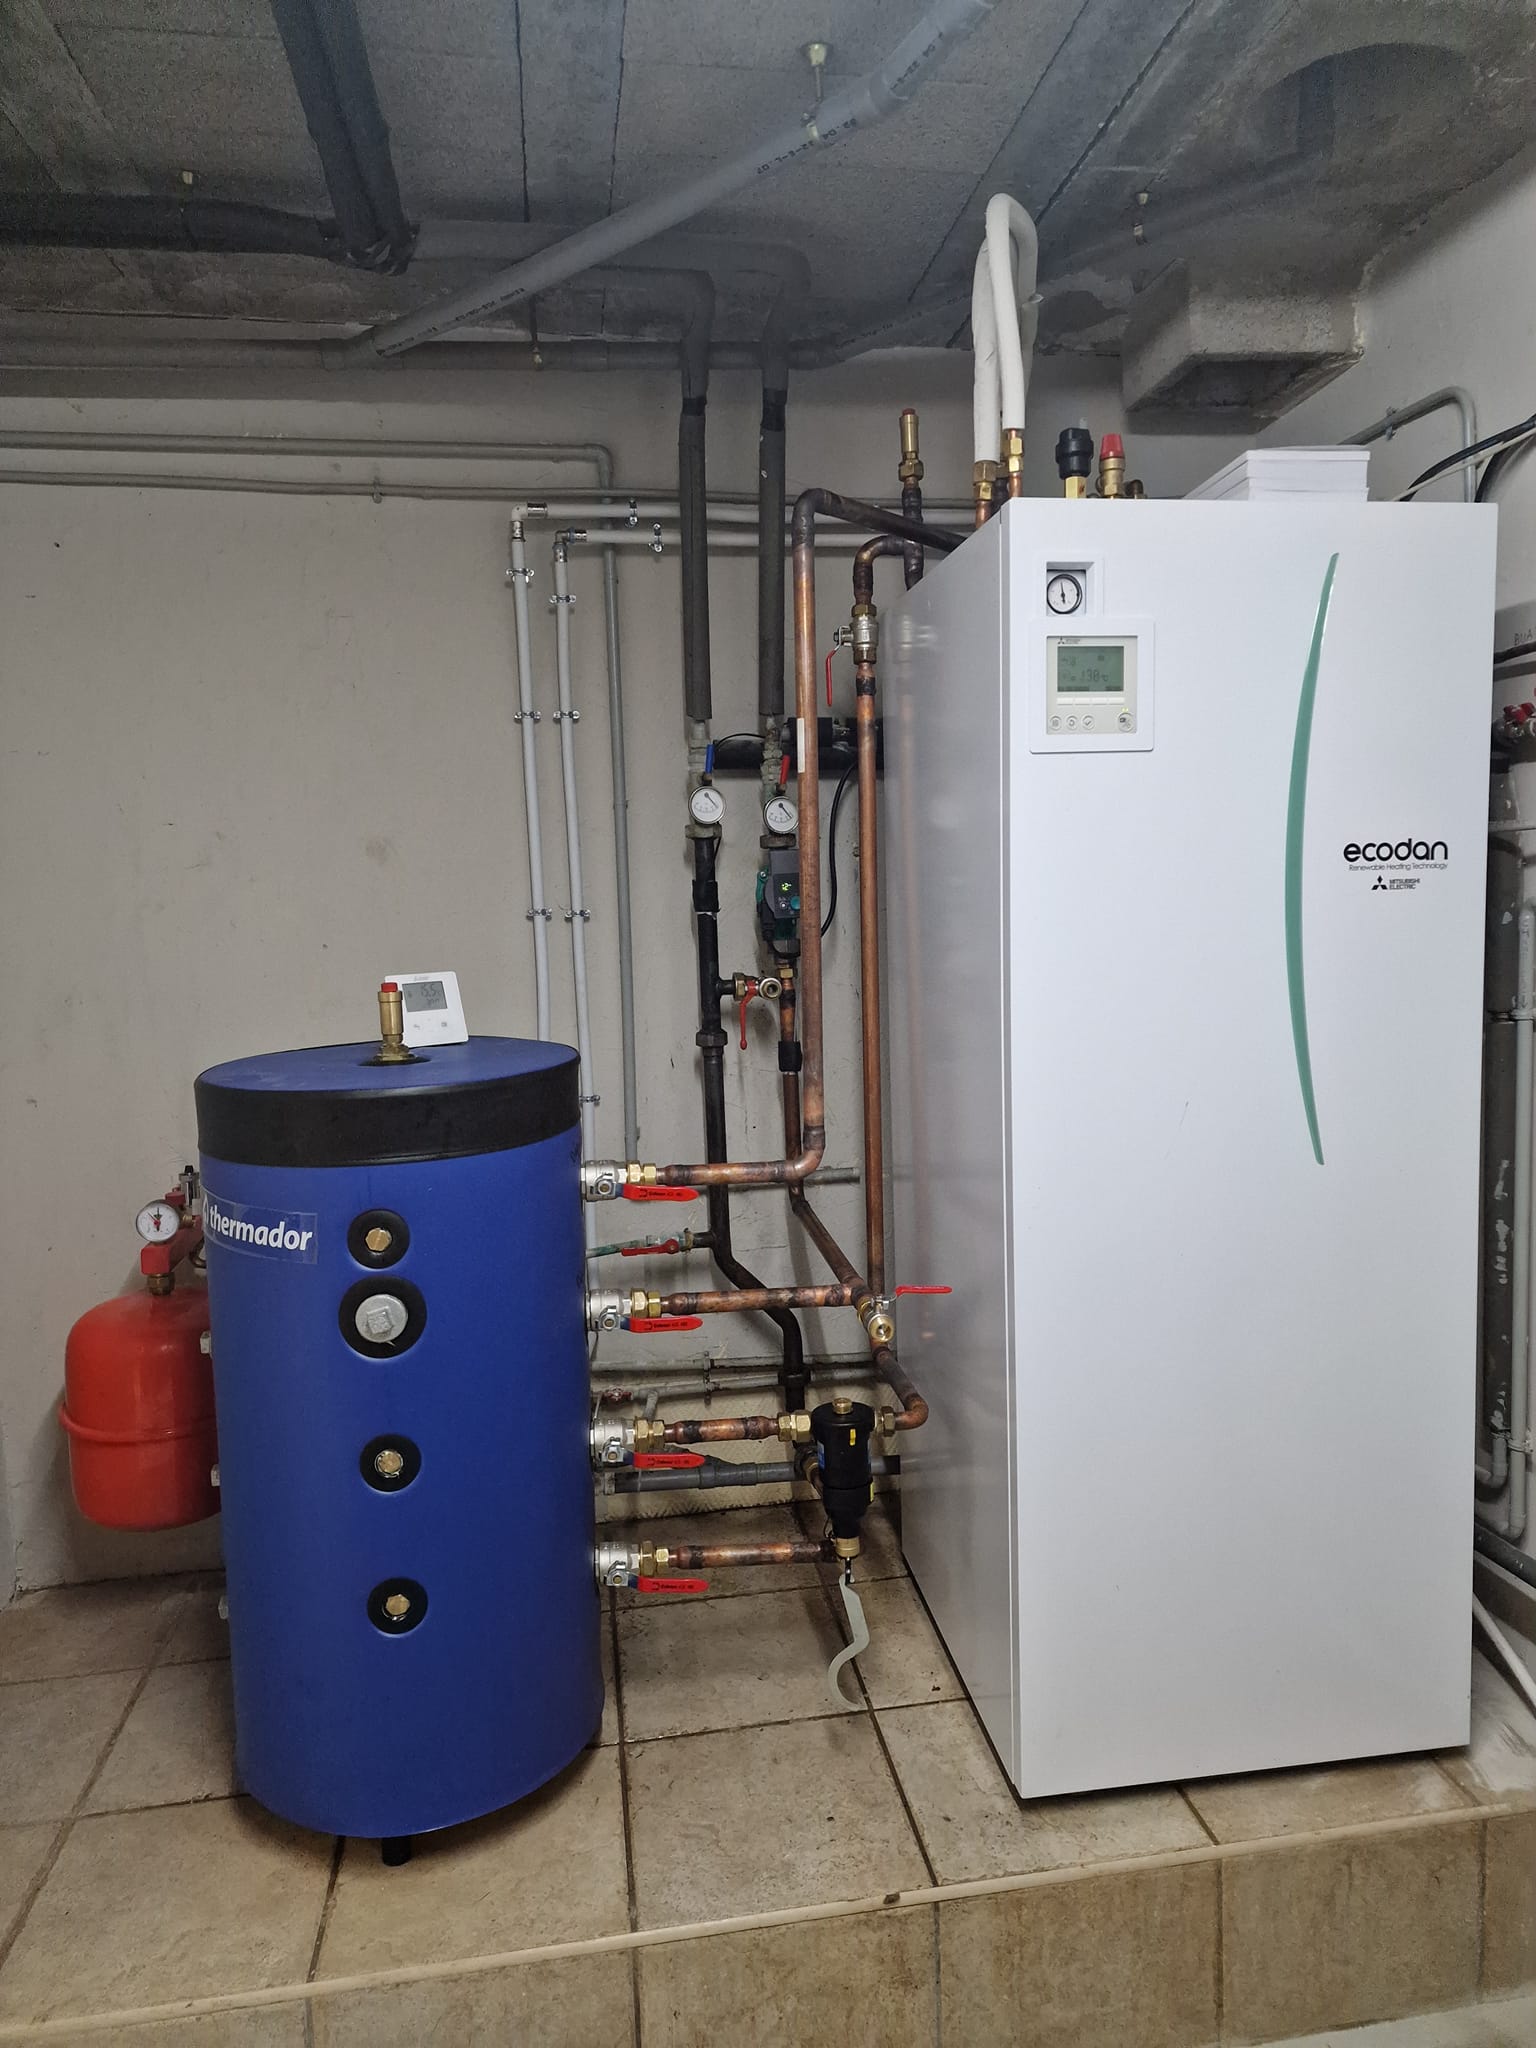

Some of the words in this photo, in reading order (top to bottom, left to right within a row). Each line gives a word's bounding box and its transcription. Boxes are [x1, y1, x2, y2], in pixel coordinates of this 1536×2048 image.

[1343, 838, 1448, 862] ecodan
[1348, 863, 1386, 871] Renewable
[1386, 862, 1411, 871] Heating
[1411, 862, 1448, 870] Technology
[210, 1204, 312, 1251] thermador
